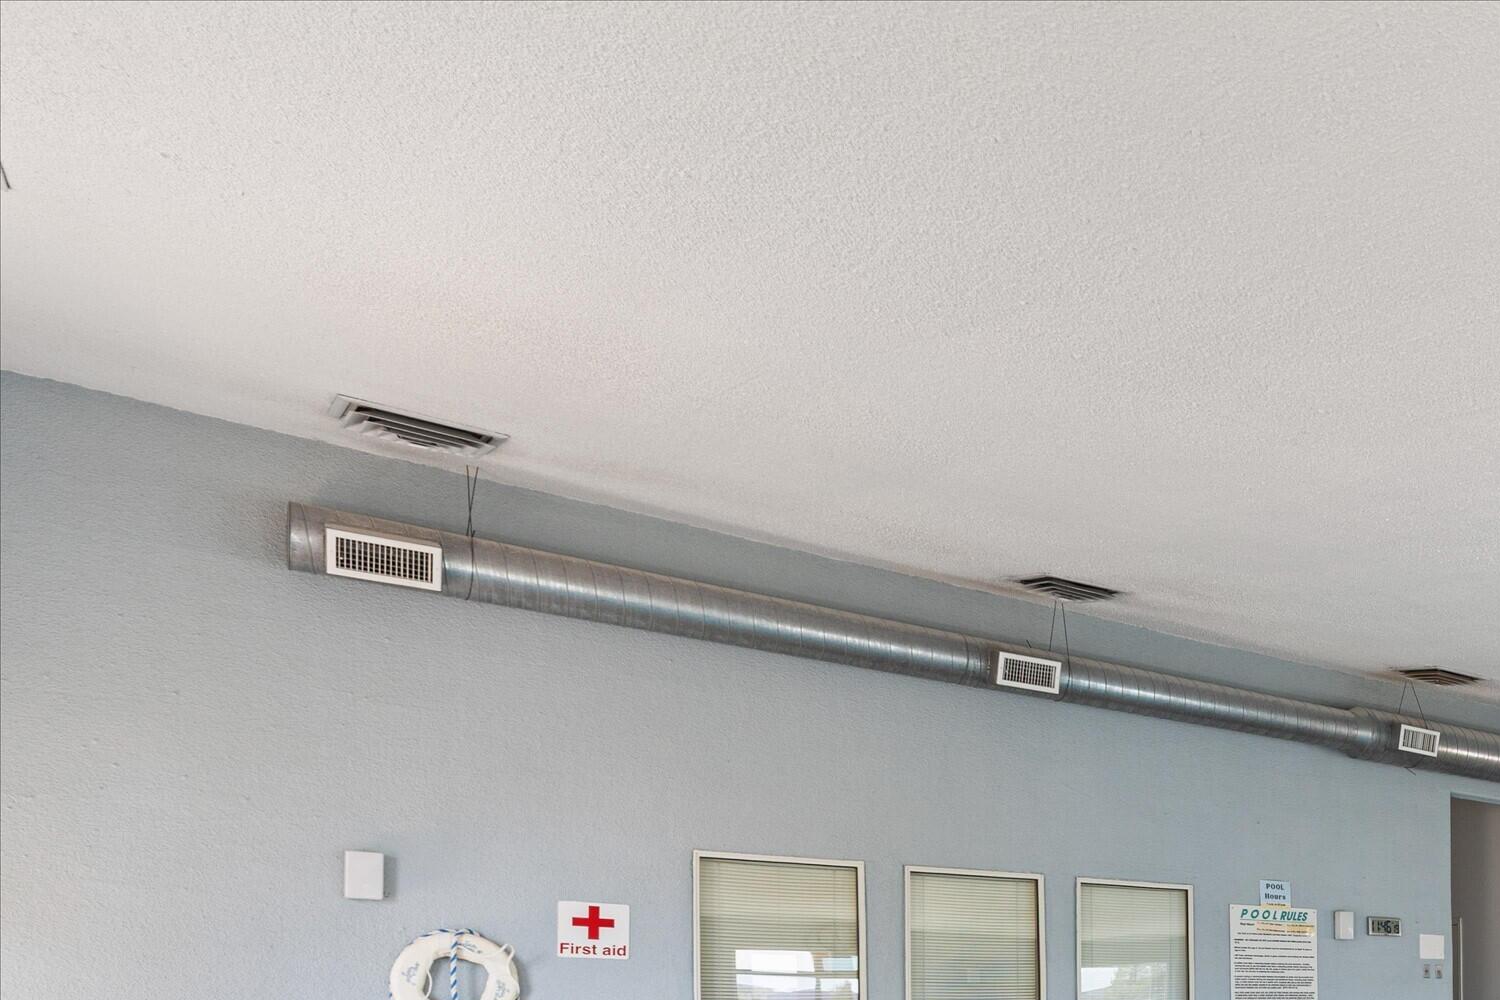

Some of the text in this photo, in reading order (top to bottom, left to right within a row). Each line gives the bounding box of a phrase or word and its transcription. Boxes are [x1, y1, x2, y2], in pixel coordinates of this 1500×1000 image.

[1240, 909, 1308, 921] POOL RULES
[560, 942, 626, 956] First aid
